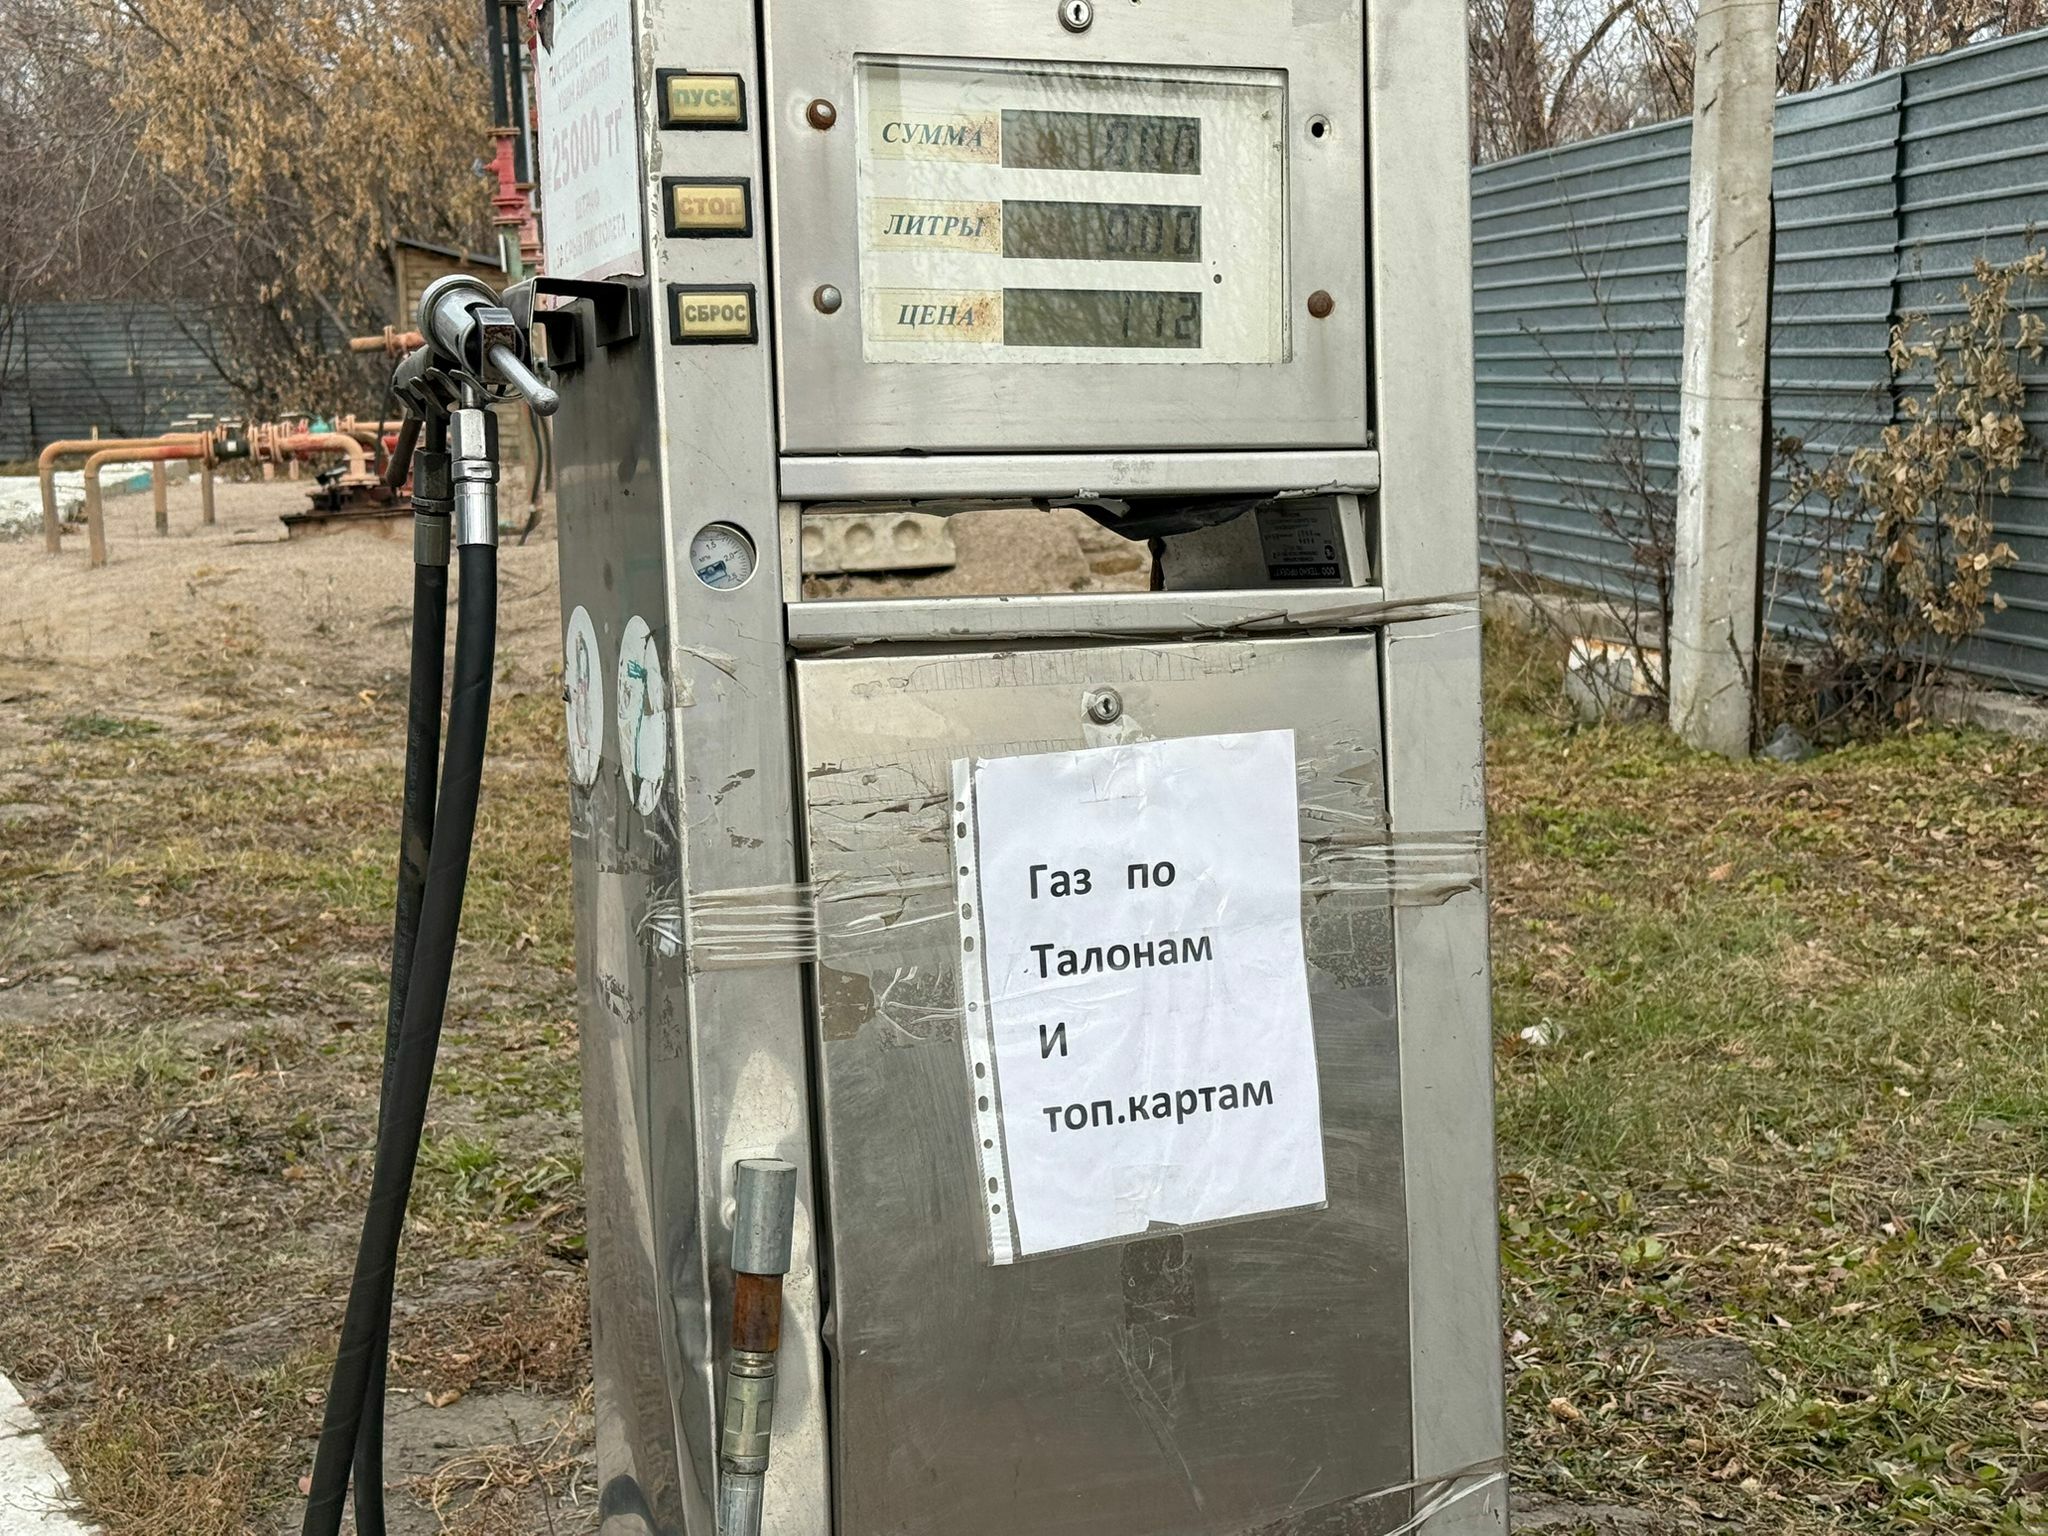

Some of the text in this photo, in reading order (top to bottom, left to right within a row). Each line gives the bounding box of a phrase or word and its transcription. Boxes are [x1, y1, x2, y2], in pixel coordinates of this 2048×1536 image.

[674, 88, 736, 107] ПУСК
[553, 106, 600, 191] 25000
[882, 121, 982, 147] СУММА
[680, 197, 741, 216] СТОП
[883, 214, 984, 237] ЛИТРЫ
[685, 304, 746, 322] СБРОС
[897, 304, 975, 329] ЦЕНА
[1123, 295, 1197, 340] 112
[1029, 860, 1176, 900] Газ по
[1030, 935, 1213, 979] Талонам
[1039, 1022, 1068, 1059] И
[1043, 1078, 1274, 1133] топ.картам
